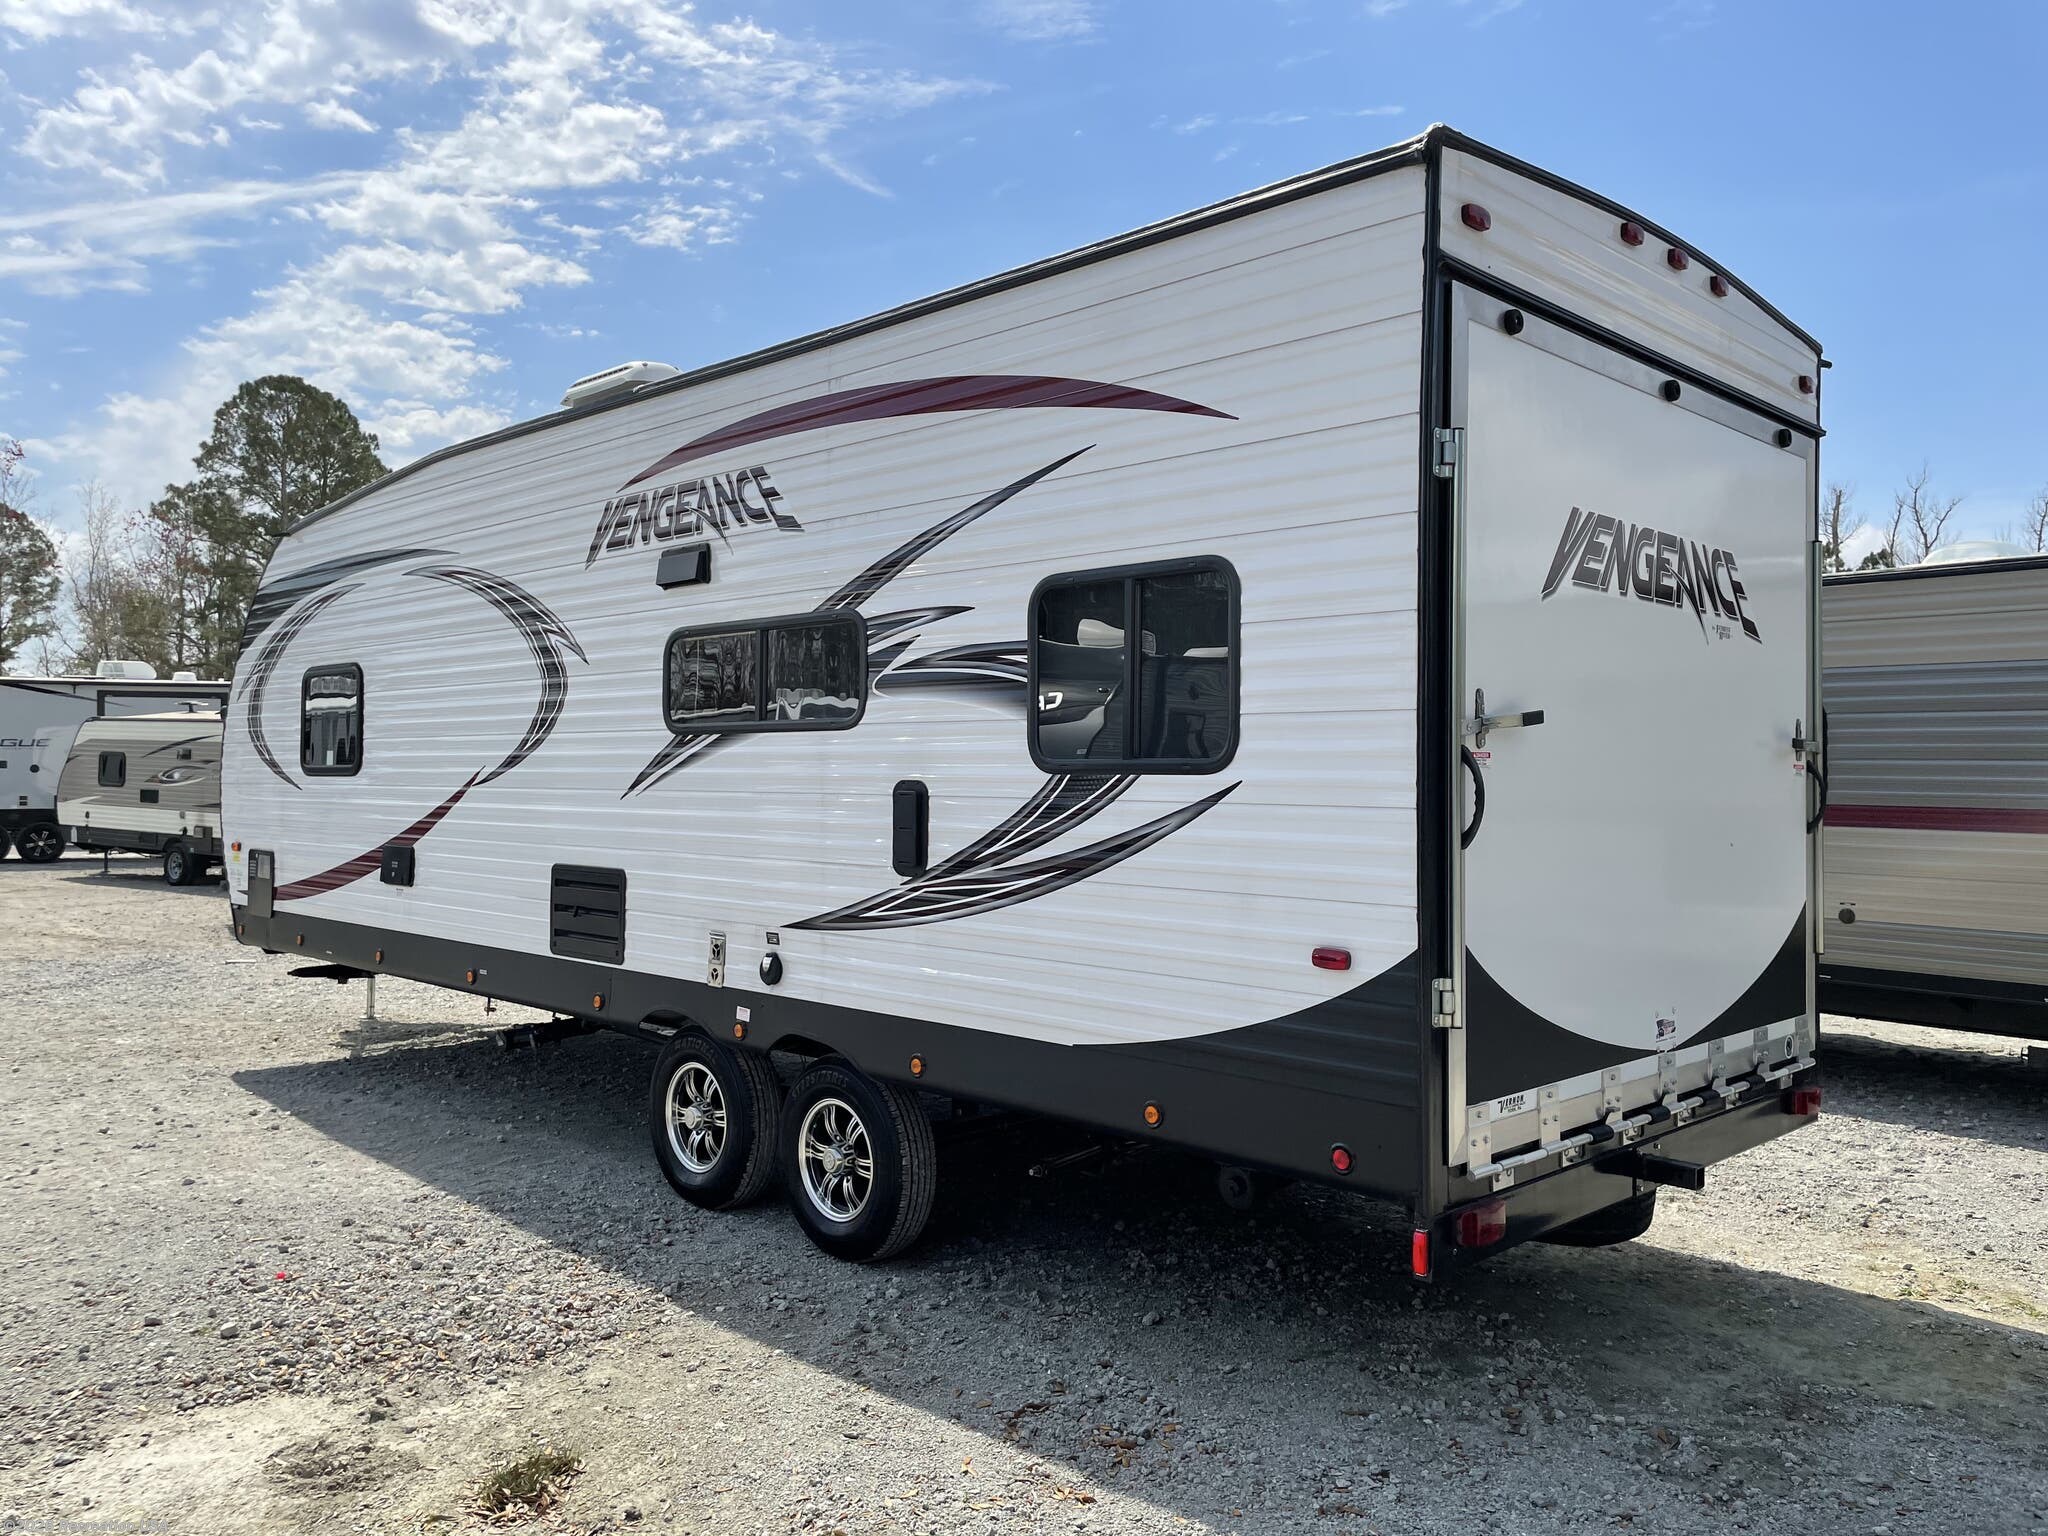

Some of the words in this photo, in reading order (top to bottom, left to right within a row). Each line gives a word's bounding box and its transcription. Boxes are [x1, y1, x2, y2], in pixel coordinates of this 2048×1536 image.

[585, 466, 805, 570] VENGEANCE
[1541, 506, 1762, 645] VENGEANCE
[1497, 1095, 1524, 1113] VERNON
